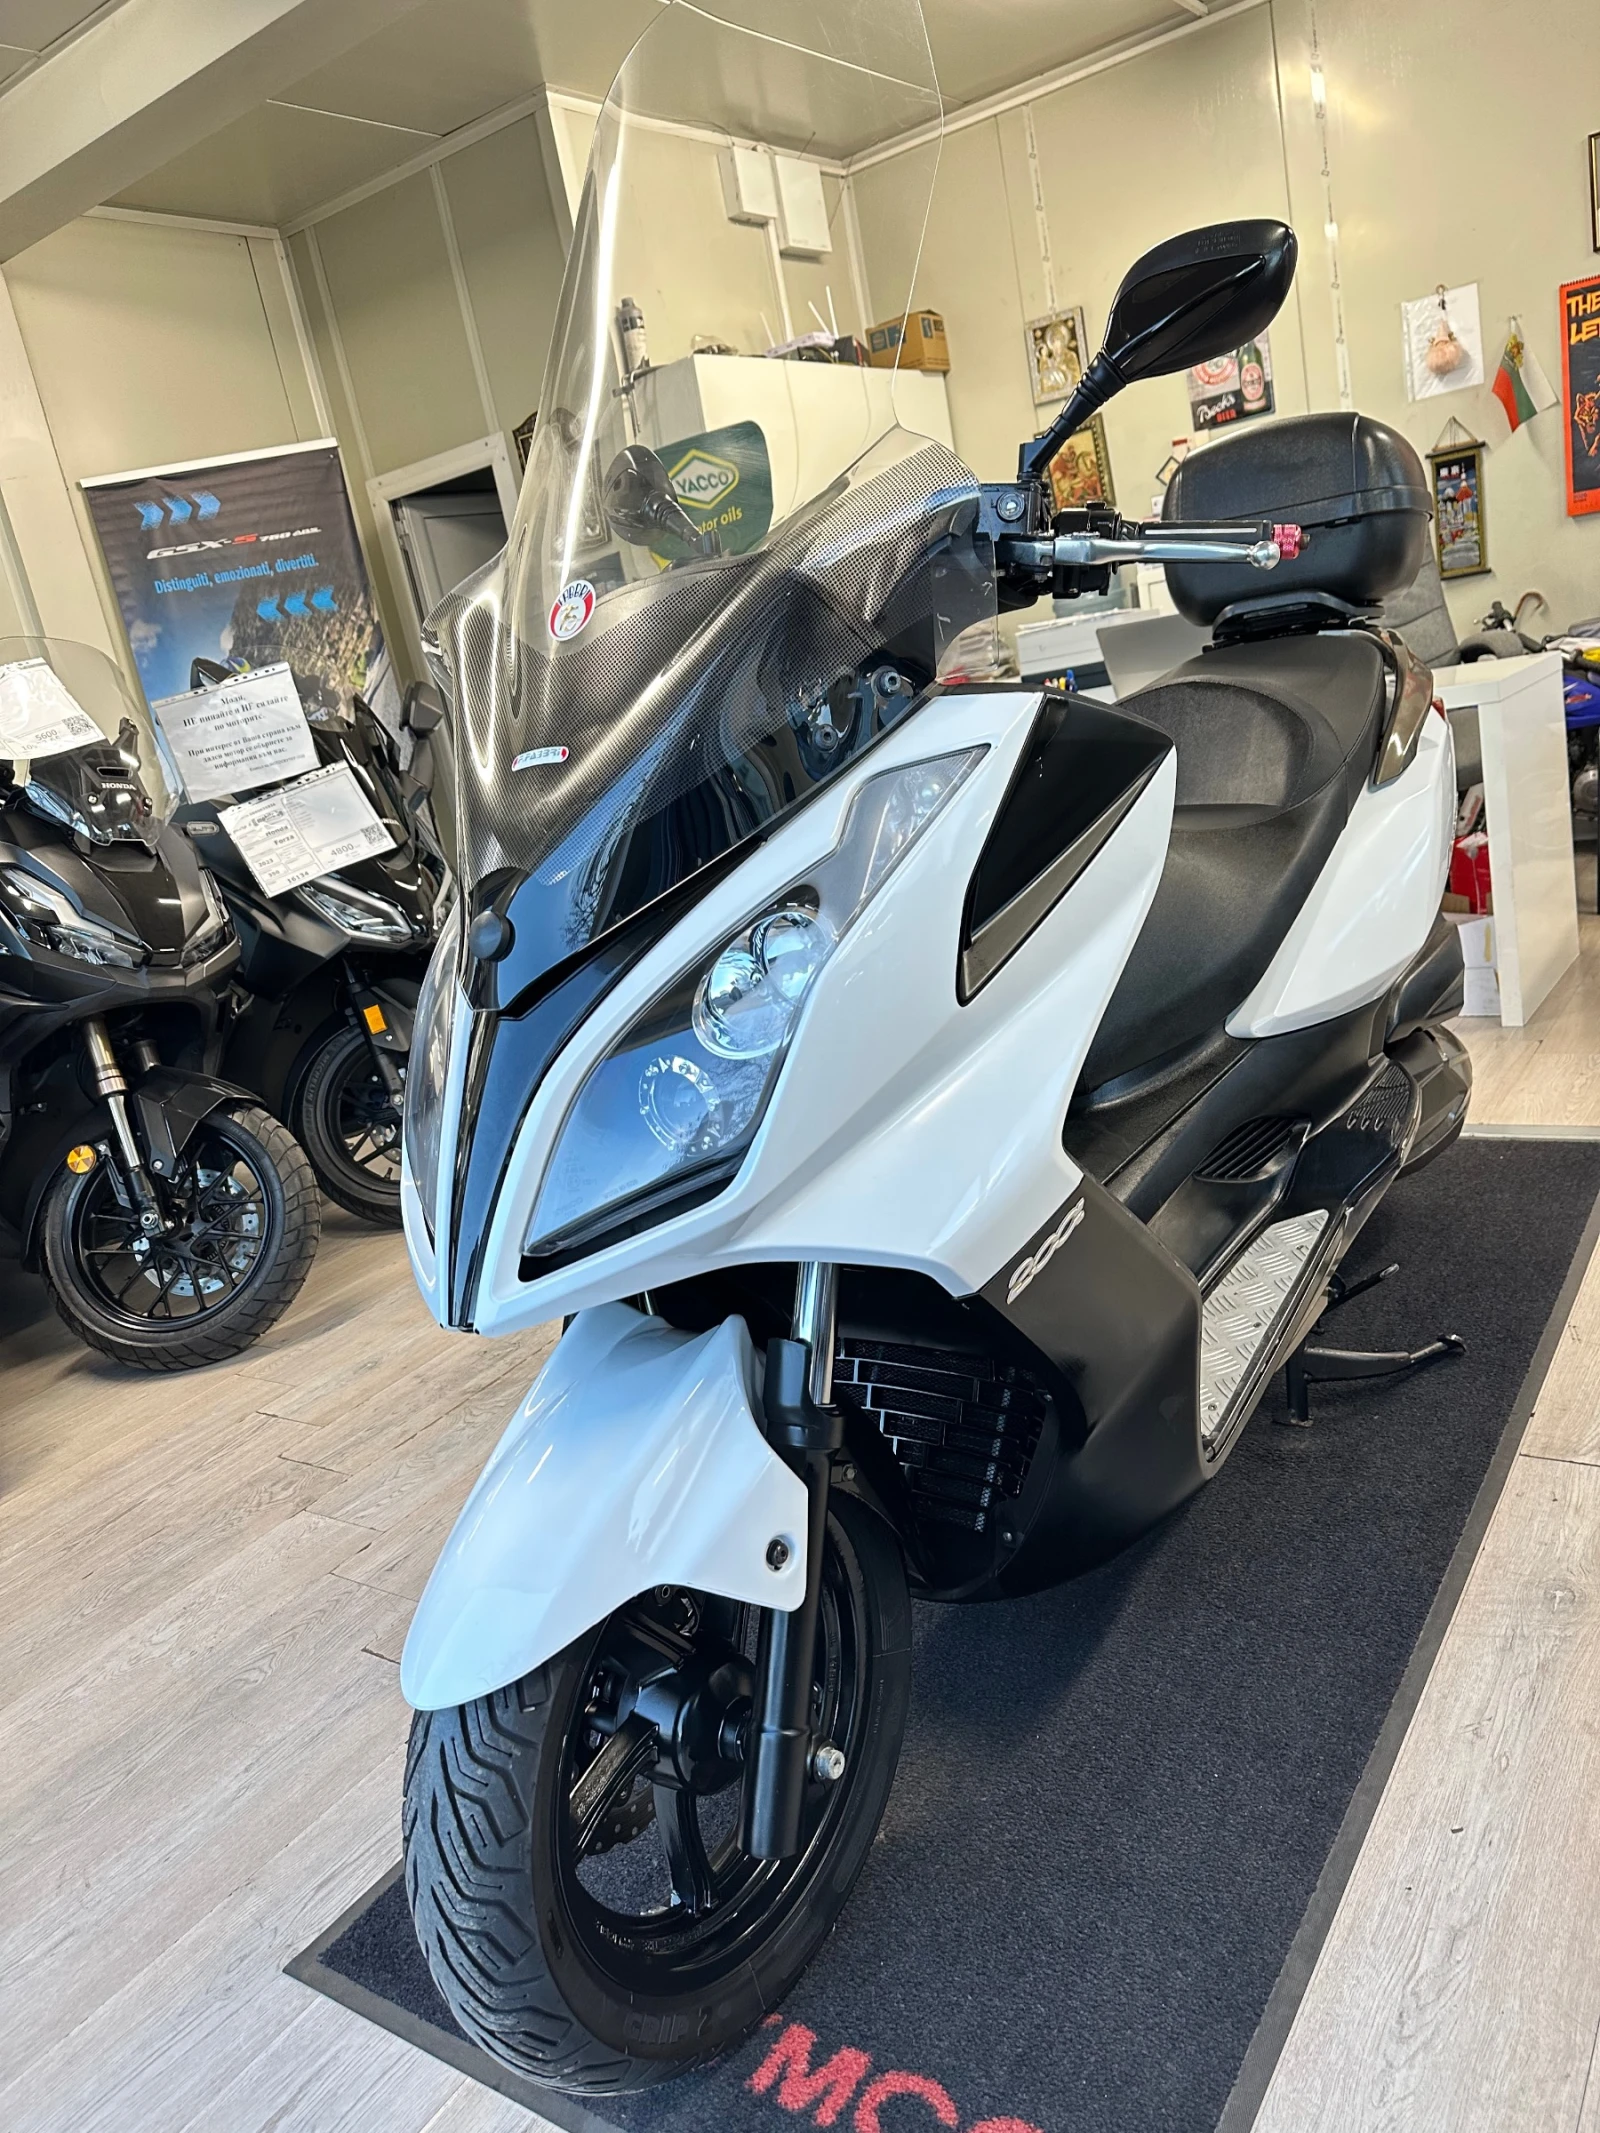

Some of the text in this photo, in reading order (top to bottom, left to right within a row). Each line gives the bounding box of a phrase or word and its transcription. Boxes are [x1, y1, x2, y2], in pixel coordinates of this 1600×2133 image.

[676, 471, 729, 493] YACCO
[720, 506, 743, 525] oils
[147, 533, 258, 559] GSX-S
[154, 552, 319, 594] Distinguiti, emozionati, divertiti.
[183, 717, 197, 727] НЕ
[35, 728, 58, 741] 5600
[101, 782, 137, 791] HONDA
[273, 833, 295, 846] Forza
[330, 843, 355, 857] 4800
[623, 2010, 690, 2045] GRIP
